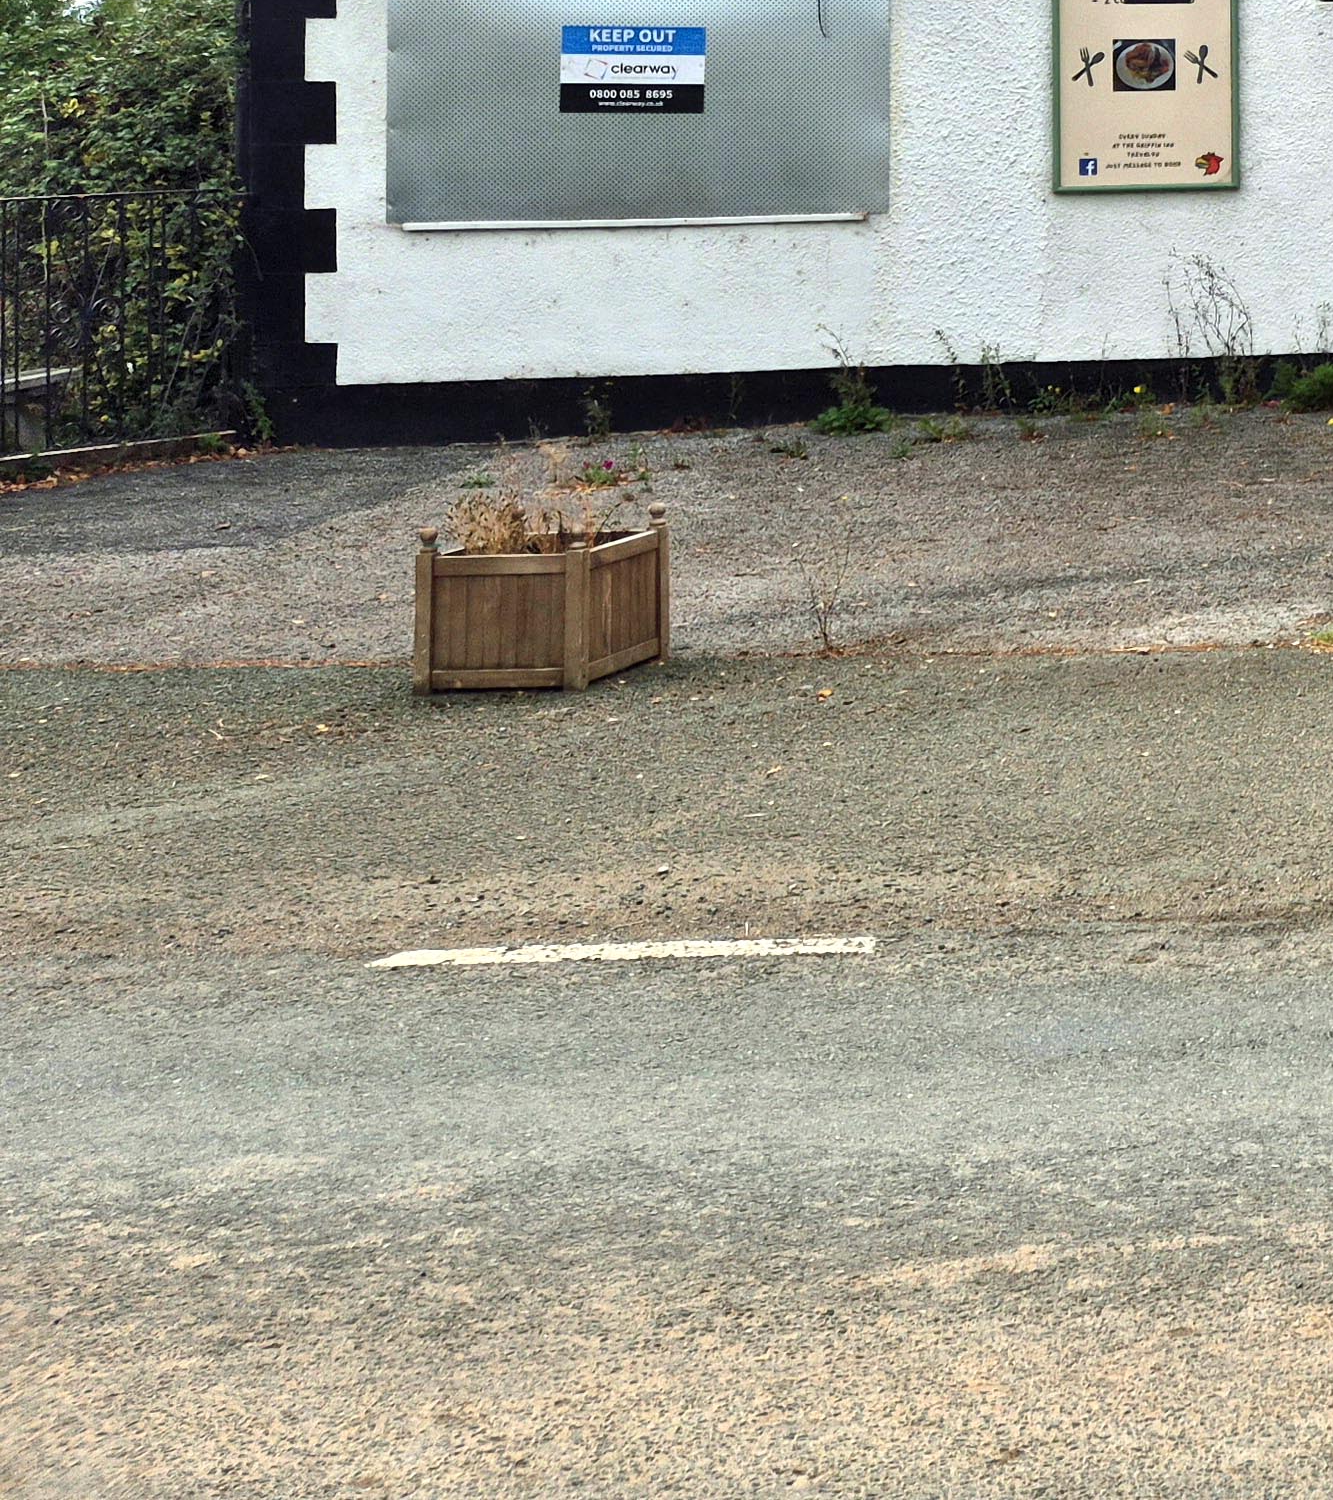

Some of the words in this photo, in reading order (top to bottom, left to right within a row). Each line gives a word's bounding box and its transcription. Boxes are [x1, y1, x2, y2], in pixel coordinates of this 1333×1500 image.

[589, 28, 635, 43] KEEP
[638, 29, 677, 43] OUT
[591, 44, 635, 52] PROPERTY
[636, 44, 673, 52] SECURED
[611, 63, 678, 80] clearway
[589, 89, 617, 99] 0800
[619, 89, 640, 99] 085
[645, 89, 673, 99] 8695
